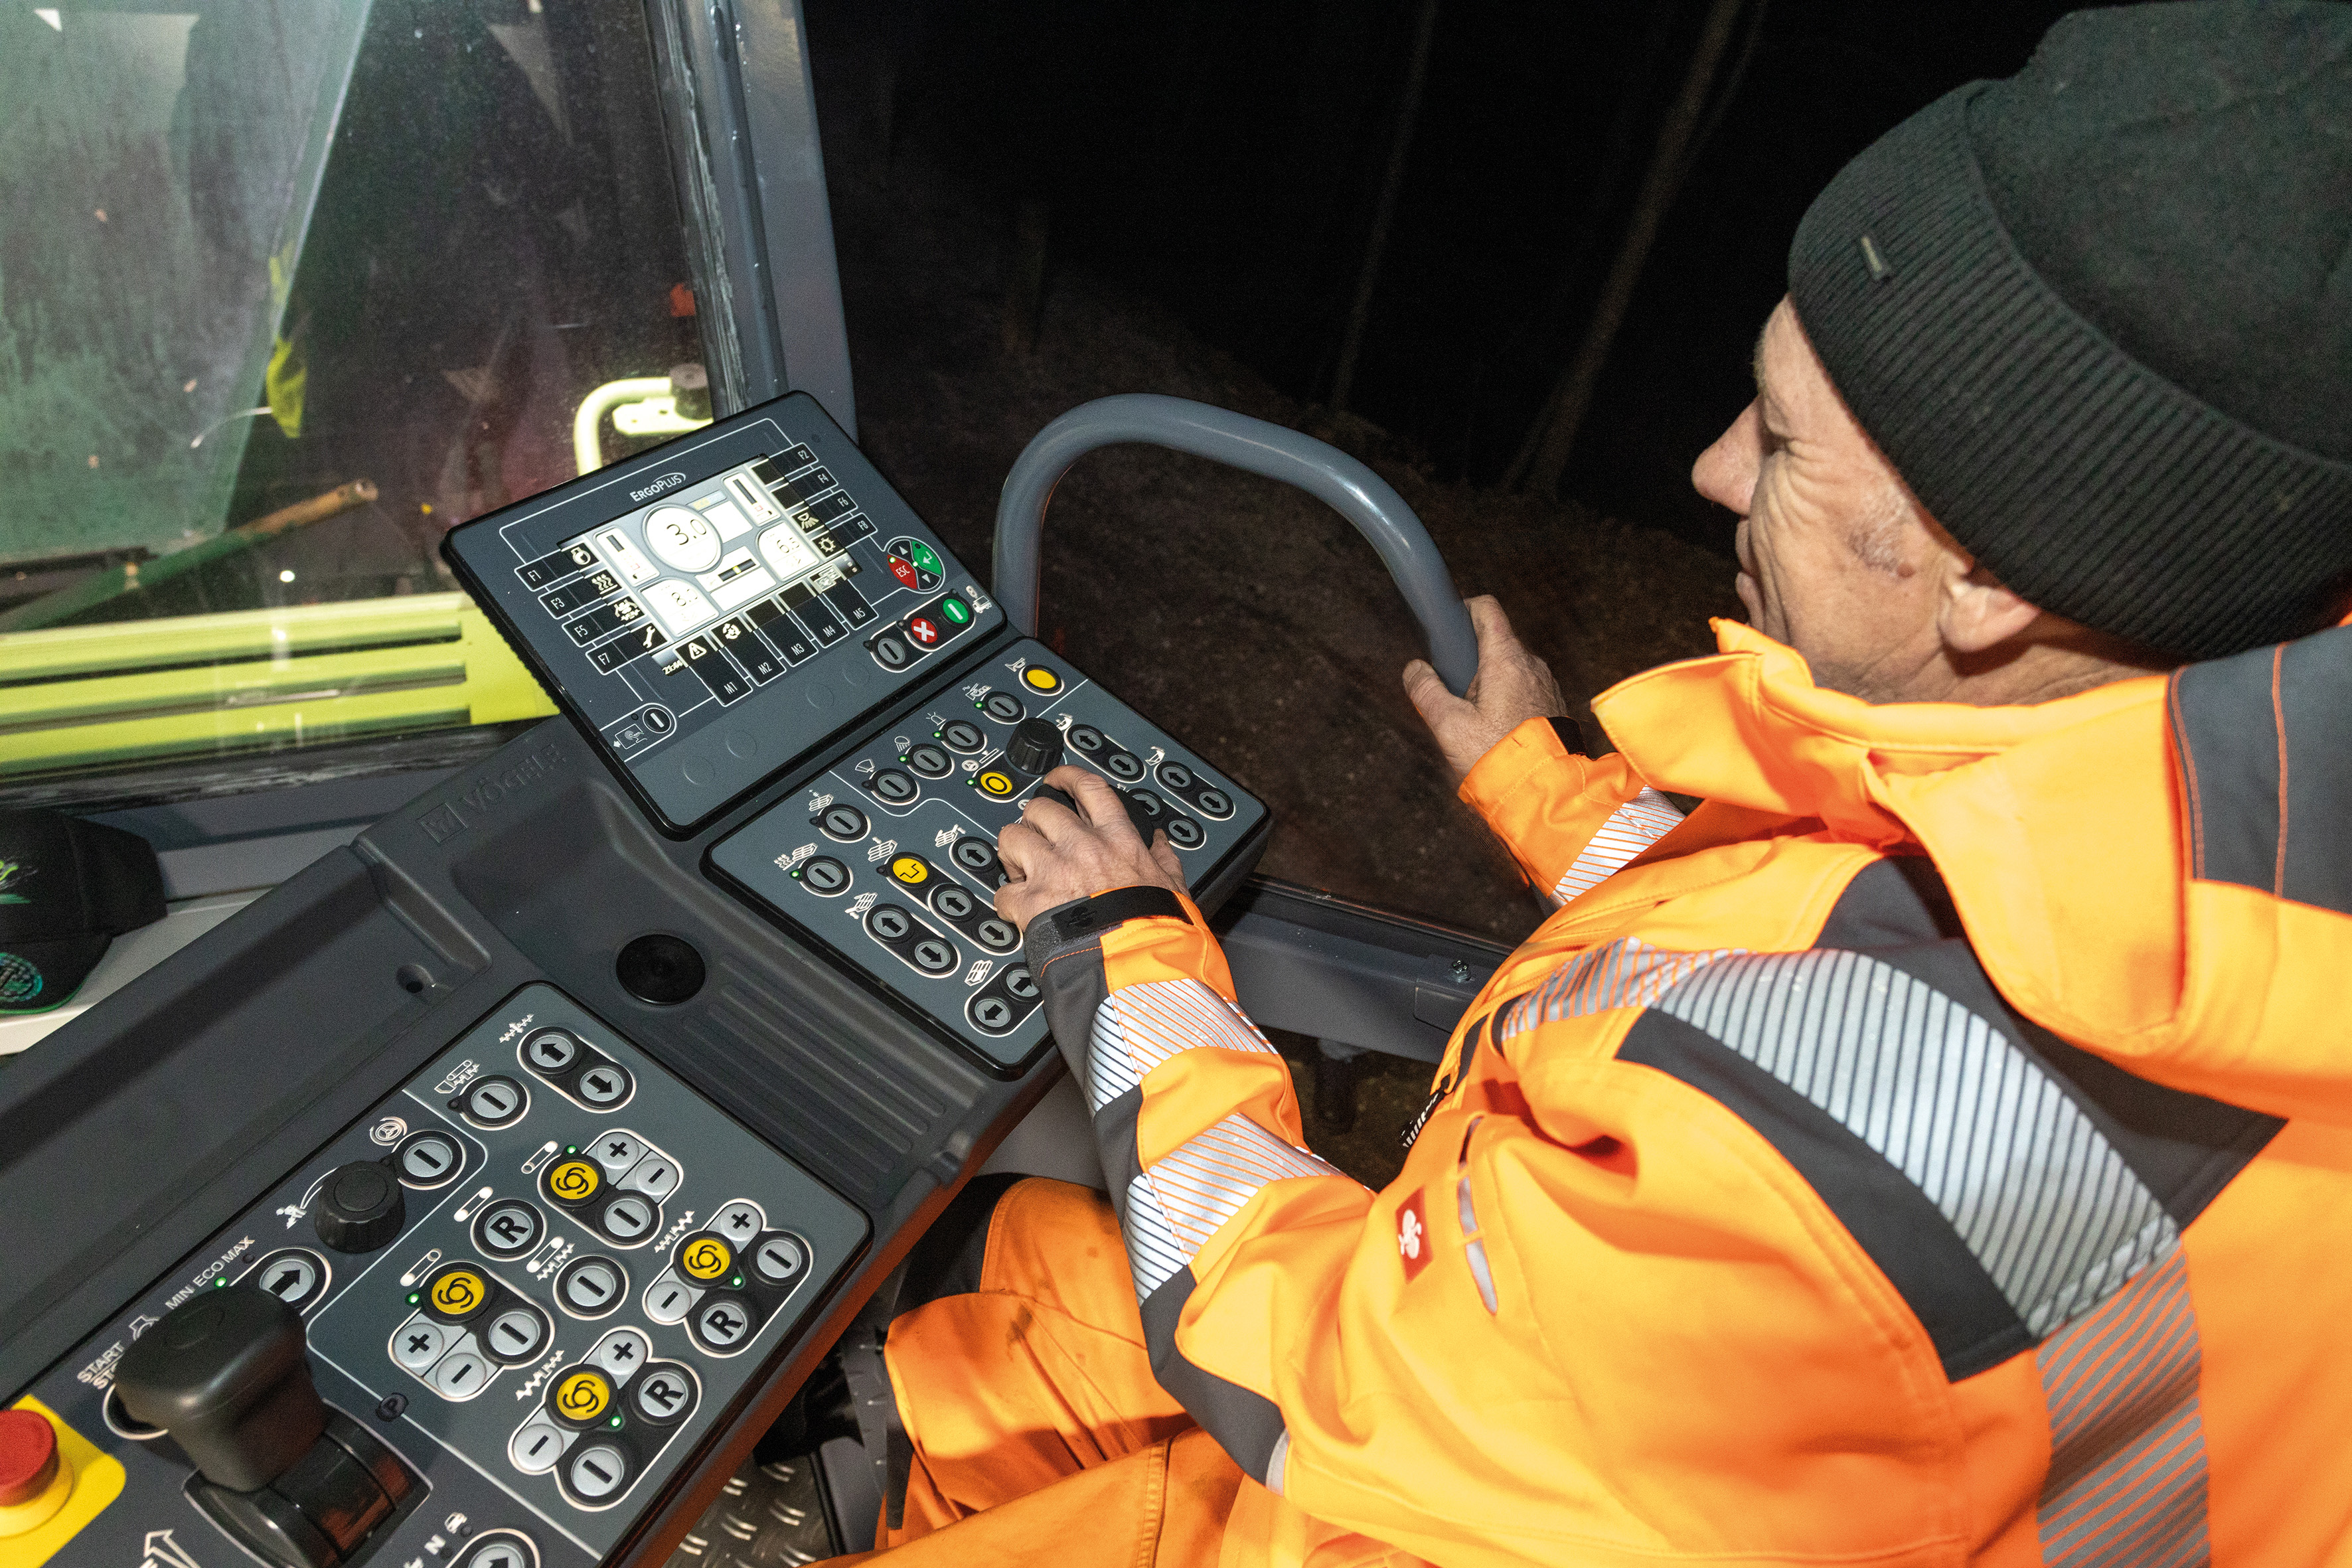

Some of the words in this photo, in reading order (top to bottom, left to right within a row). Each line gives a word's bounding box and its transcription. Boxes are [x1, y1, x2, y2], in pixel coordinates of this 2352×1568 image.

[797, 448, 810, 460] F2
[817, 471, 830, 484] F4
[836, 495, 850, 507] F6
[856, 518, 870, 530] F8
[666, 518, 707, 546] 3.0
[776, 537, 800, 554] 6.5
[527, 570, 542, 582] F1
[895, 564, 911, 578] ESC
[550, 597, 565, 609] F3
[852, 607, 866, 620] M5
[574, 625, 588, 638] F5
[822, 625, 836, 638] M4
[790, 643, 805, 656] M3
[597, 653, 611, 665] F7
[757, 662, 773, 675] M2
[723, 681, 738, 694] M1
[490, 1215, 530, 1244] R
[165, 1285, 194, 1310] MIN
[193, 1261, 224, 1287] ECO
[221, 1235, 255, 1263] MAX
[706, 1309, 744, 1340] R
[77, 1340, 125, 1383] START
[645, 1379, 684, 1411] R
[424, 1533, 446, 1555] N
